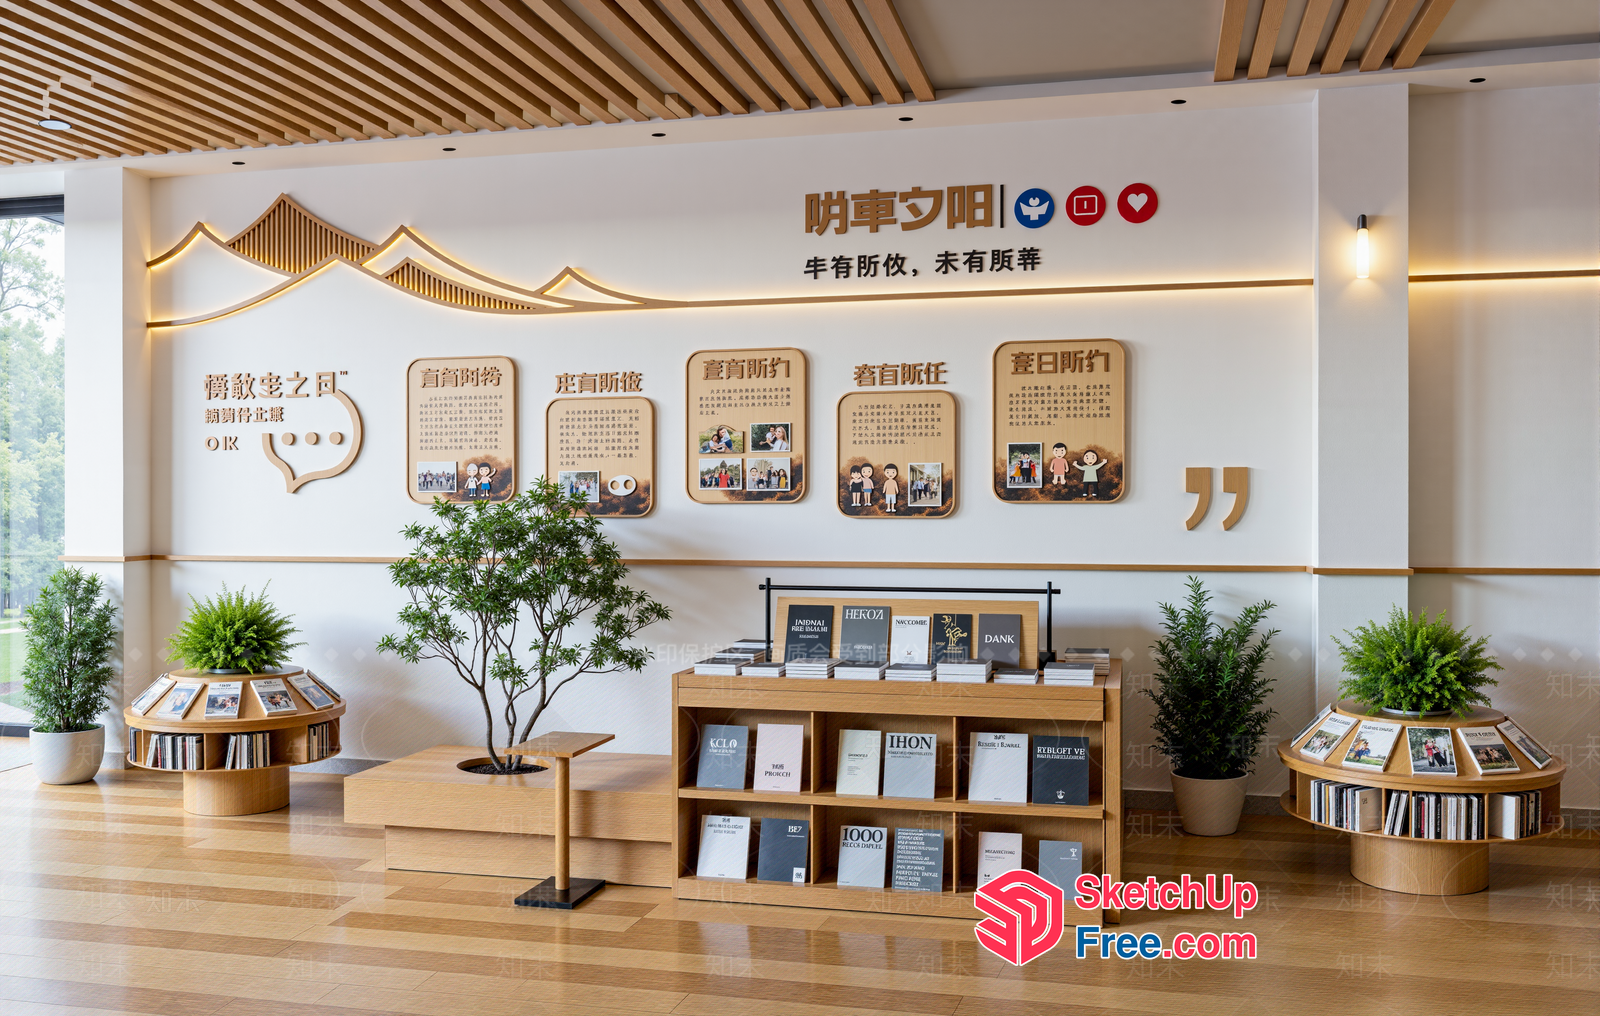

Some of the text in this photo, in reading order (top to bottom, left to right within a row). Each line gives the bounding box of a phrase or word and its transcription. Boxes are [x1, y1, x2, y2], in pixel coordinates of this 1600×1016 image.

[984, 634, 1016, 644] DANK
[889, 734, 933, 750] IHON
[842, 827, 884, 844] 1000
